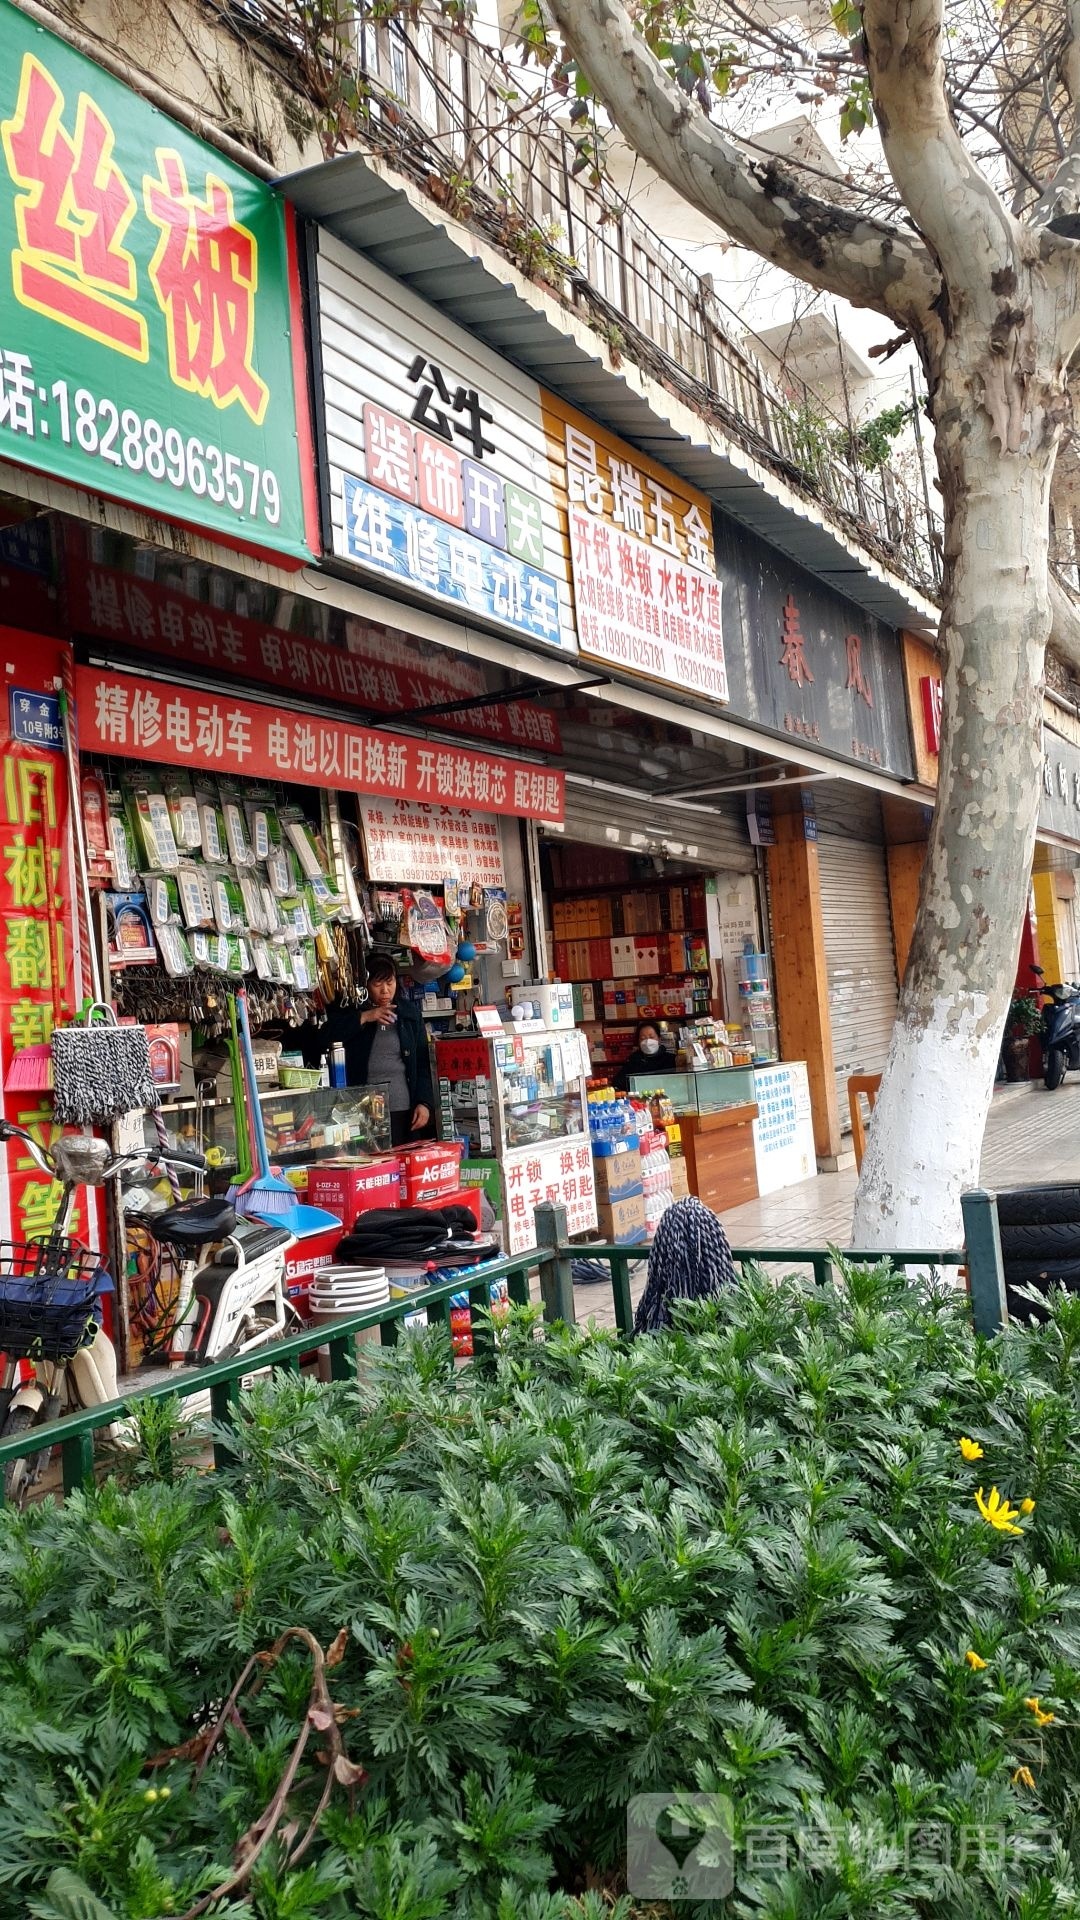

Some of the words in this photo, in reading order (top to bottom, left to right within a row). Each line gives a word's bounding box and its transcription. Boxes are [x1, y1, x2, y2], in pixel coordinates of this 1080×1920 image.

[1, 52, 270, 427] 丝被
[407, 354, 496, 459] 公牛
[368, 408, 541, 562] 装饰开关
[566, 423, 713, 577] 昆瑞五金
[352, 485, 560, 639] 维修电动车
[573, 513, 614, 580] 开锁
[616, 534, 654, 602] 换锁
[657, 559, 721, 631] 水电改造
[577, 569, 624, 622] 太阳能维修
[20, 697, 64, 719] 穿金
[95, 680, 253, 763] 精修电动车
[267, 717, 408, 790] 电池以旧换新
[415, 748, 507, 805] 开锁换锁芯
[513, 769, 560, 815] 配钥匙
[254, 1056, 276, 1072] 钥匙
[508, 1157, 543, 1189] 开锁
[559, 1146, 591, 1176] 换锁
[510, 1174, 593, 1218] 电子配钥匙
